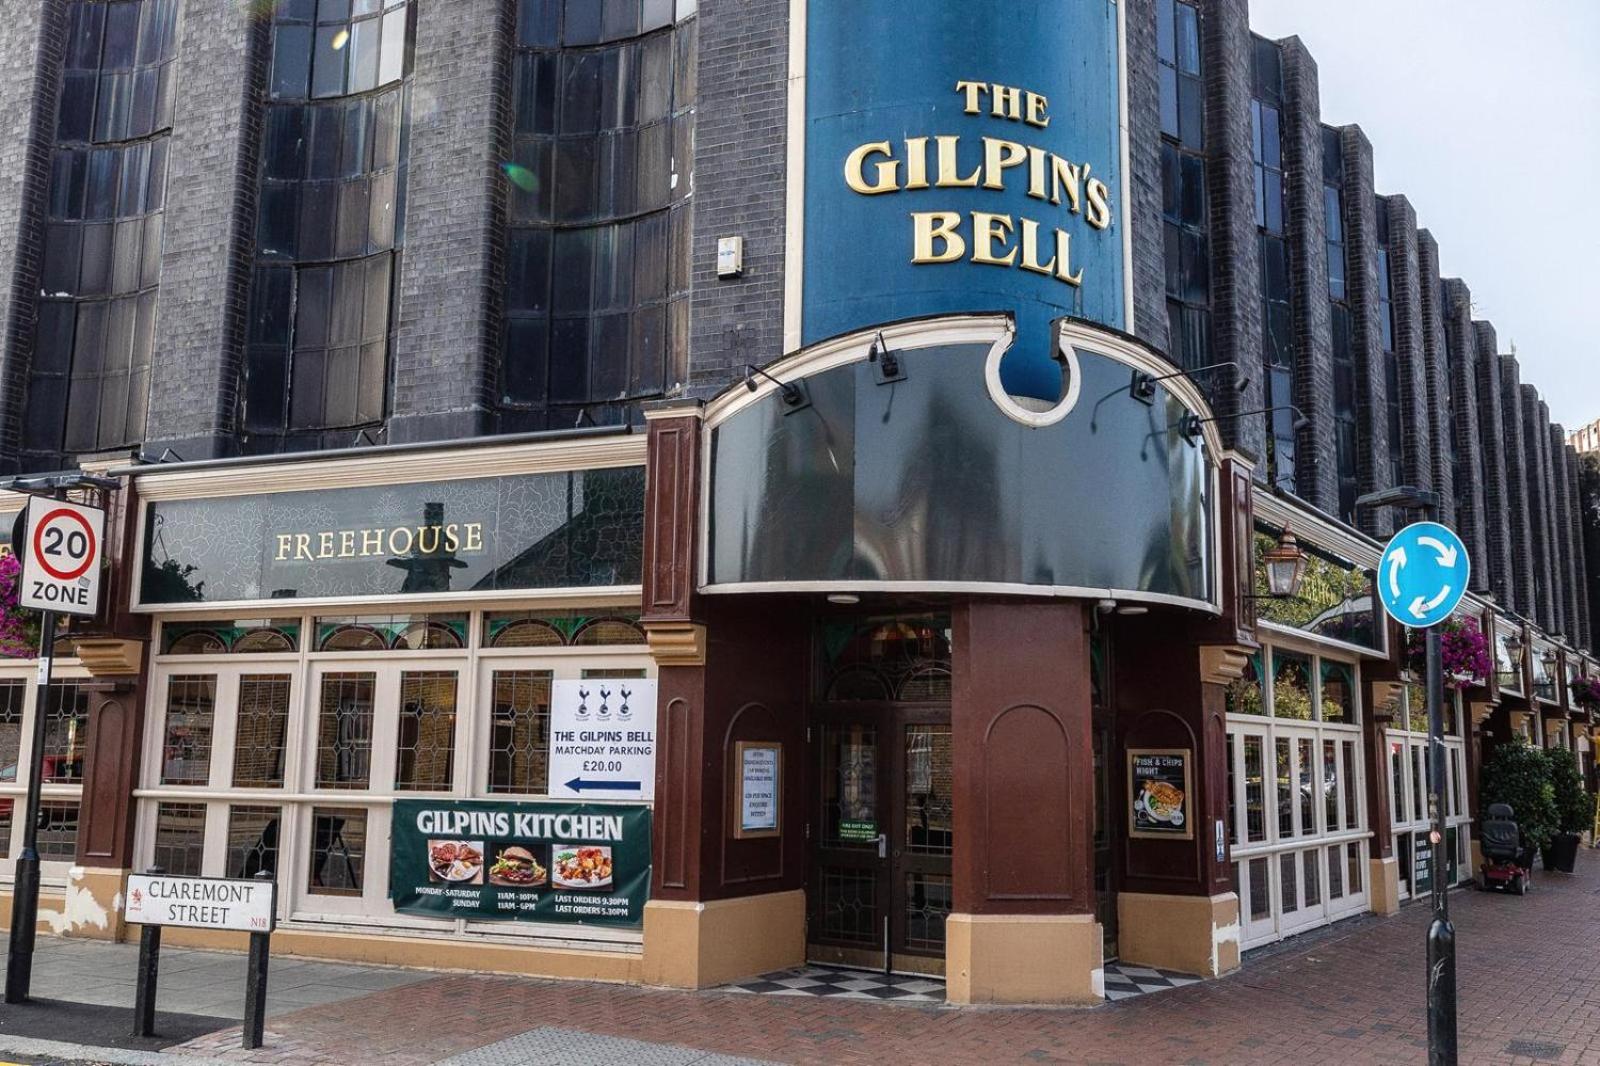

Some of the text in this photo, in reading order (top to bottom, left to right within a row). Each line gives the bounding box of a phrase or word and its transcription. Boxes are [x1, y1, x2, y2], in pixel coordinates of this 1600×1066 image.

[956, 80, 1051, 128] THE
[844, 135, 1110, 230] GILPIN'S
[910, 211, 1084, 287] BELL
[44, 527, 87, 559] 20
[275, 523, 483, 561] FREEHOUSE
[32, 581, 89, 605] ZONE
[554, 731, 654, 742] THE GILPINS BELL
[555, 746, 652, 755] MATCHDAY PARKING
[583, 761, 622, 772] £20.00
[416, 810, 623, 841] GILPINS KITCHEN
[148, 881, 254, 903] CLAREMONT
[555, 895, 572, 903] LAST
[573, 896, 601, 904] ORDERS
[168, 904, 230, 924] STREET
[452, 900, 480, 908] SUNDAY
[573, 906, 601, 914] ORDERS
